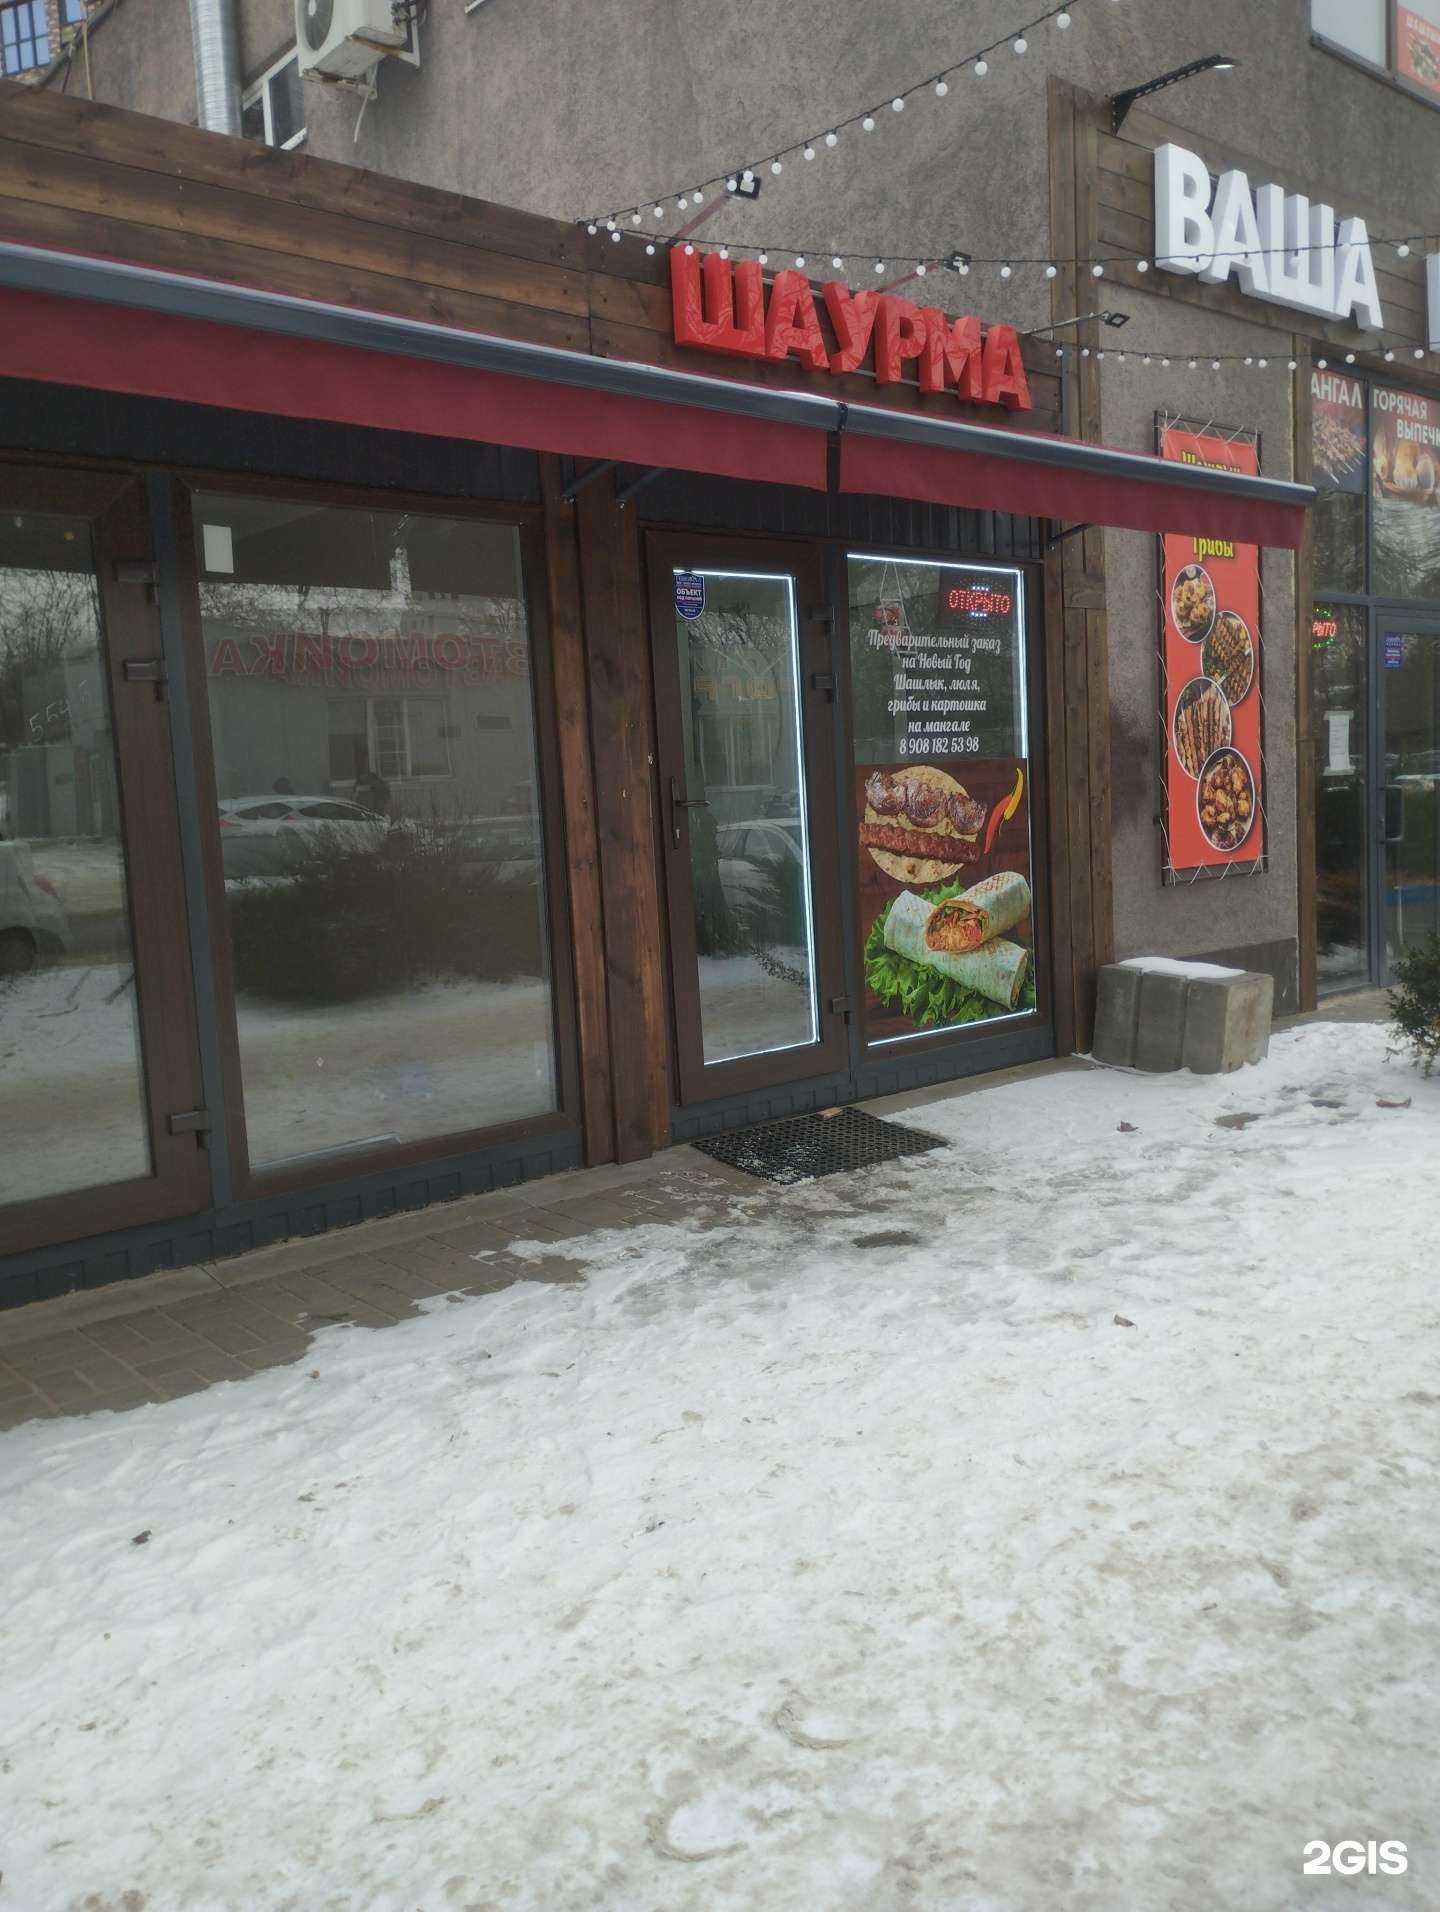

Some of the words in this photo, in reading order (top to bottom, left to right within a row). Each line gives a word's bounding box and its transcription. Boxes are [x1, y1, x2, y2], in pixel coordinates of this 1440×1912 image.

[1154, 142, 1384, 332] ВАША
[670, 242, 1034, 412] ШАУРМА
[1373, 388, 1428, 421] ГОРЯЧАЯ
[676, 587, 702, 597] ОБЪЕКТ
[948, 589, 1010, 614] ОТКРЫТО
[867, 629, 969, 651] Предварительный
[970, 638, 1001, 656] заказ
[902, 657, 916, 669] на
[916, 652, 952, 670] Новый
[952, 654, 972, 675] Год
[893, 673, 947, 693] Шашлык,
[948, 679, 981, 693] люля,
[887, 695, 921, 717] грибы
[922, 700, 930, 712] и
[930, 700, 987, 715] картошка
[908, 722, 922, 733] на
[923, 720, 971, 733] мангале
[899, 738, 907, 755] 8
[908, 737, 930, 754] 908
[931, 738, 949, 753] 182
[950, 737, 965, 753] 53
[966, 736, 980, 752] 98
